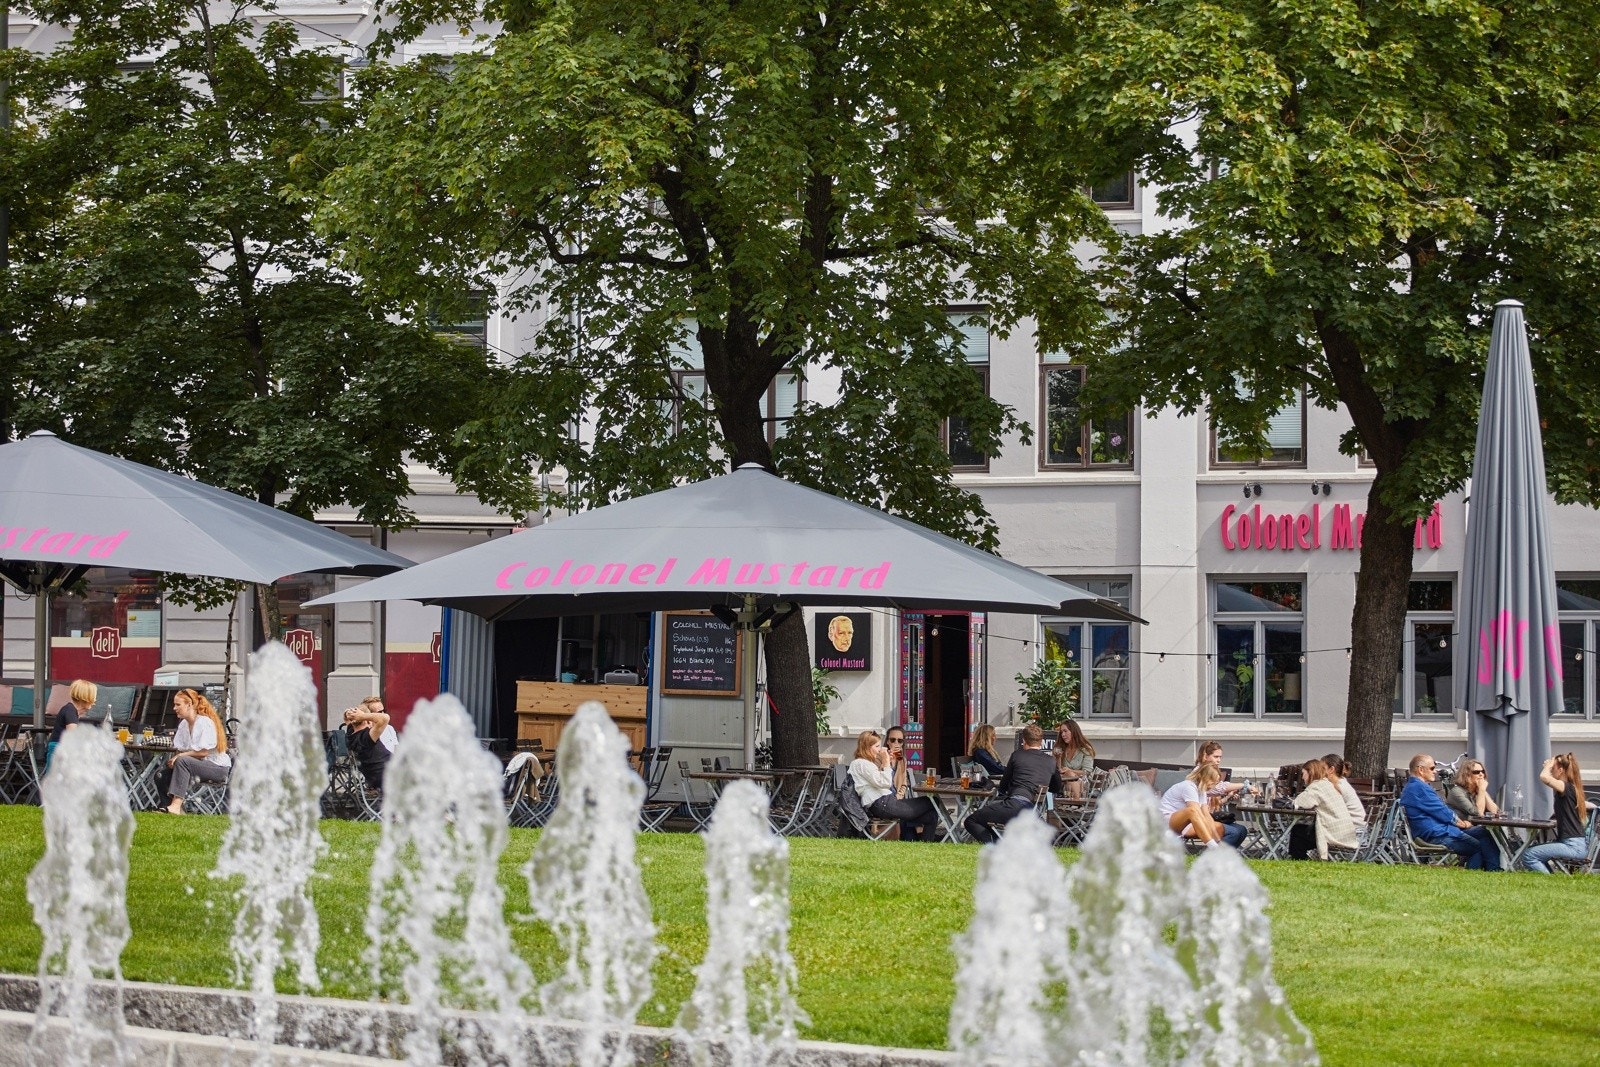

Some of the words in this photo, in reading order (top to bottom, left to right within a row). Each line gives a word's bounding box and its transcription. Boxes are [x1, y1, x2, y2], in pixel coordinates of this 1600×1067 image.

[1220, 503, 1321, 550] Colonel
[495, 557, 677, 590] Colonel
[687, 557, 893, 590] Mustard
[96, 631, 115, 652] deli
[289, 634, 309, 655] deli
[820, 657, 842, 668] Colonel
[842, 657, 865, 668] Mustard
